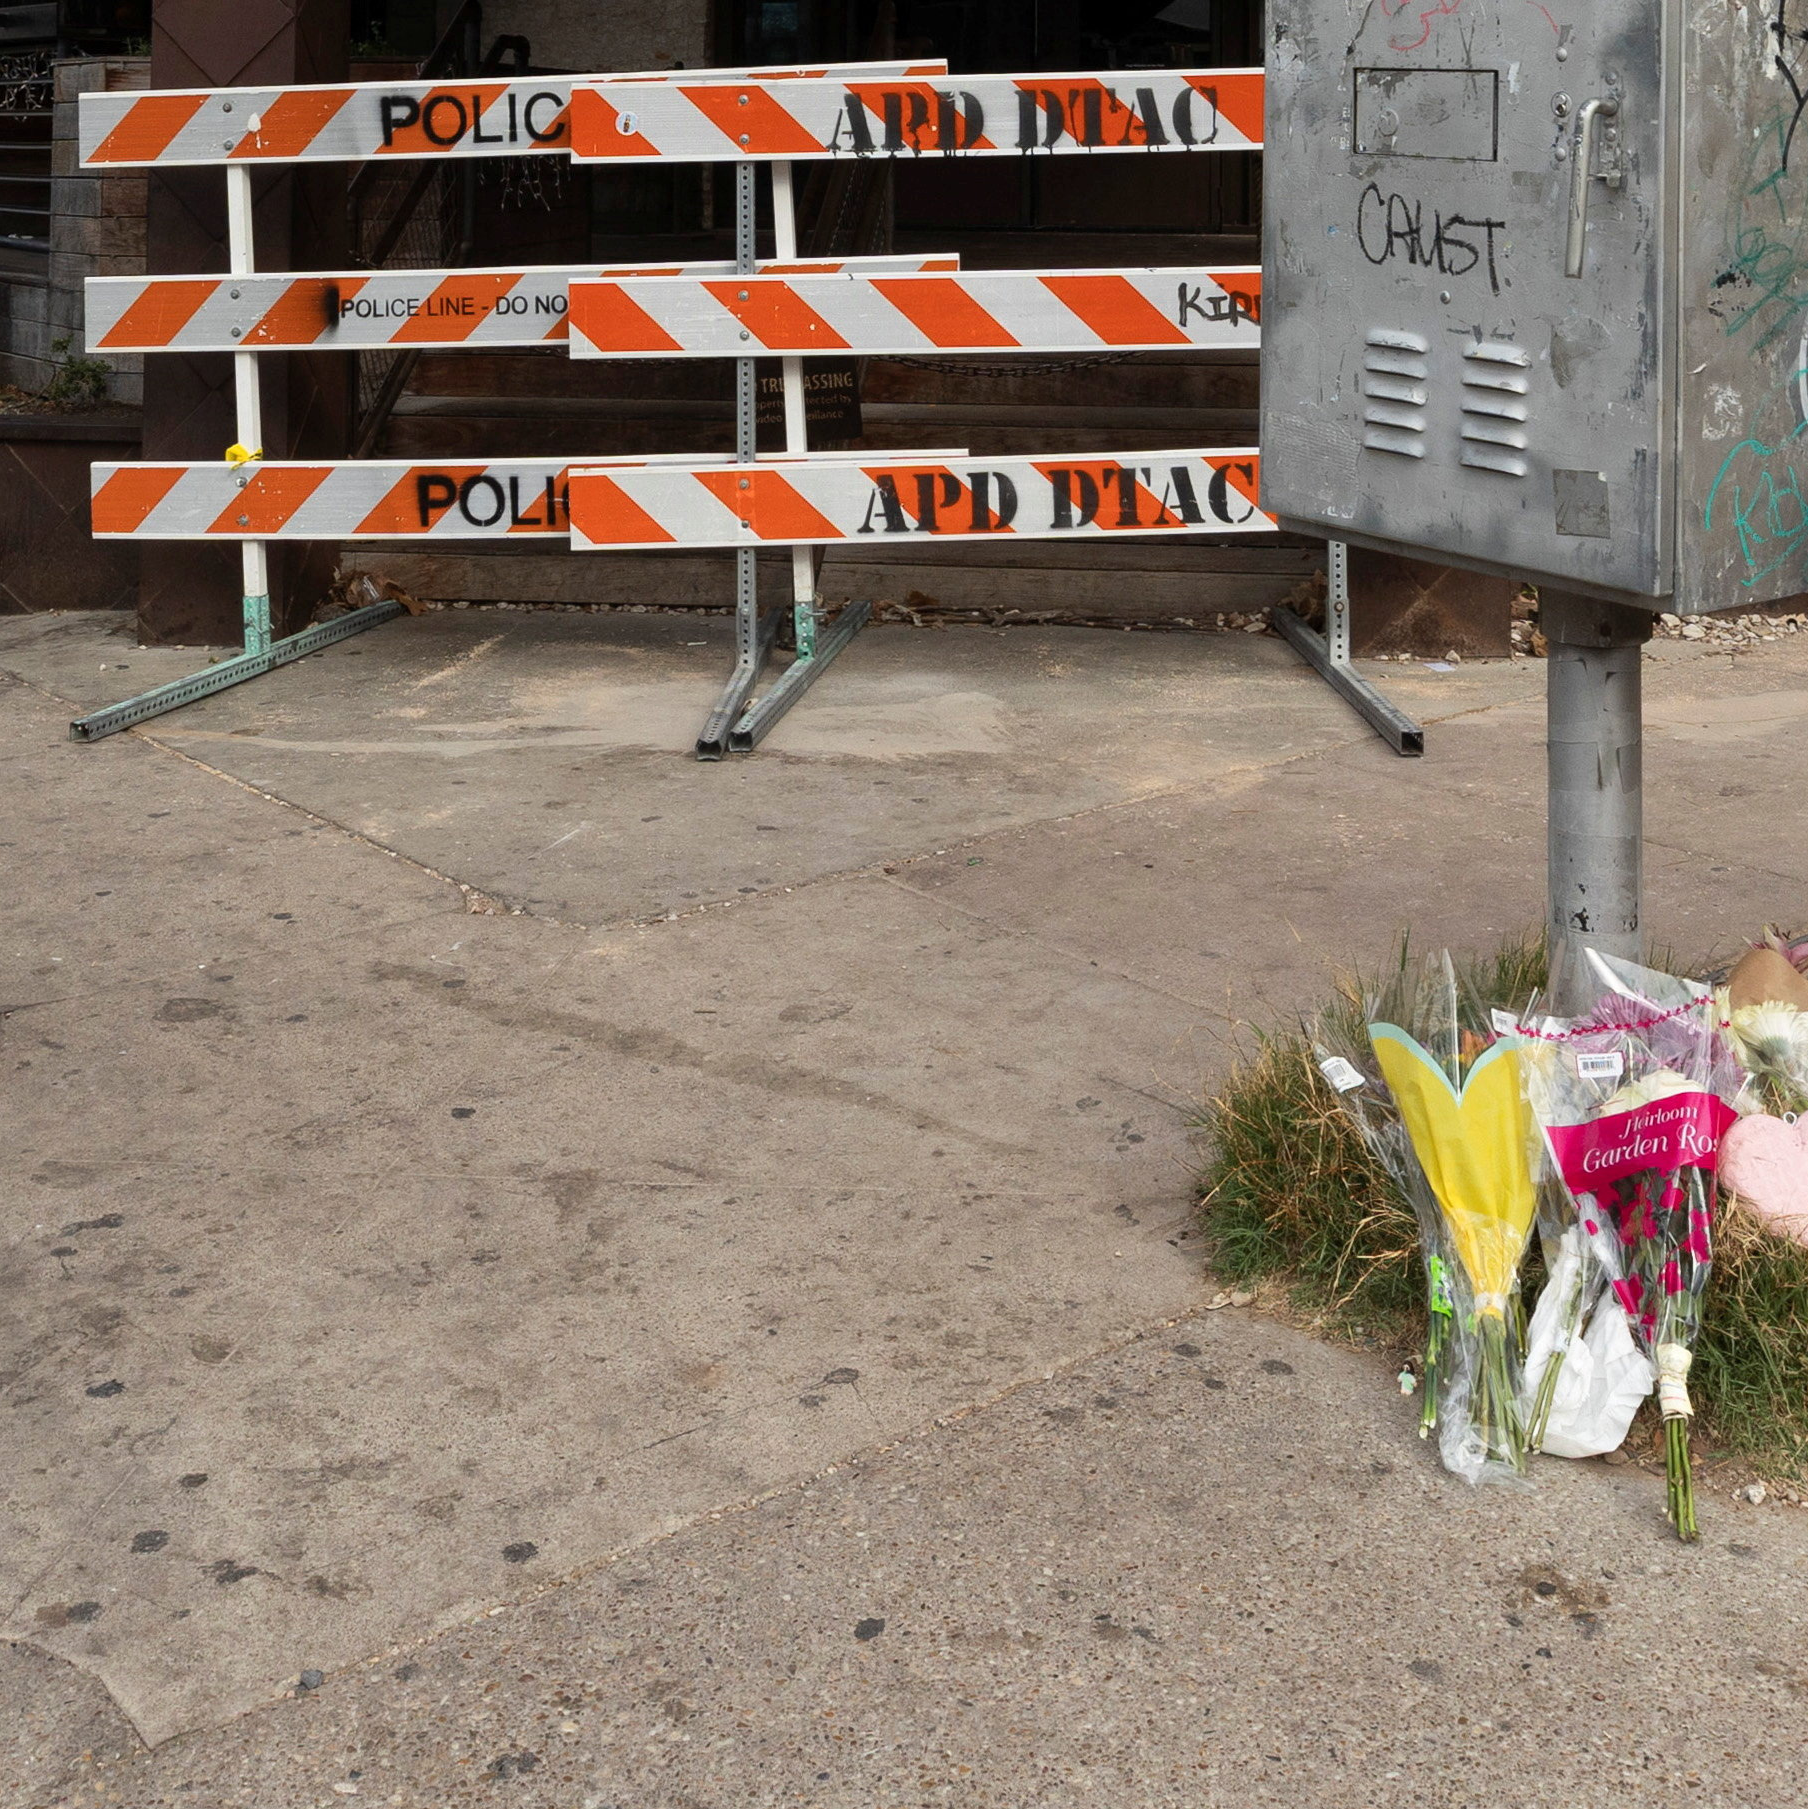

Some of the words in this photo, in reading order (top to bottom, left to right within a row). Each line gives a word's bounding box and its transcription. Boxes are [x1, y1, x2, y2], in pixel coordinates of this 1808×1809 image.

[828, 89, 985, 154] APD
[1014, 86, 1220, 150] DTAC
[340, 297, 419, 319] POLICE
[427, 296, 475, 317] LINE
[496, 295, 529, 316] DO
[856, 469, 1020, 534] APD
[1049, 462, 1256, 531] DTAC
[1619, 1106, 1698, 1139] Heirloom
[1583, 1134, 1668, 1173] Garden
